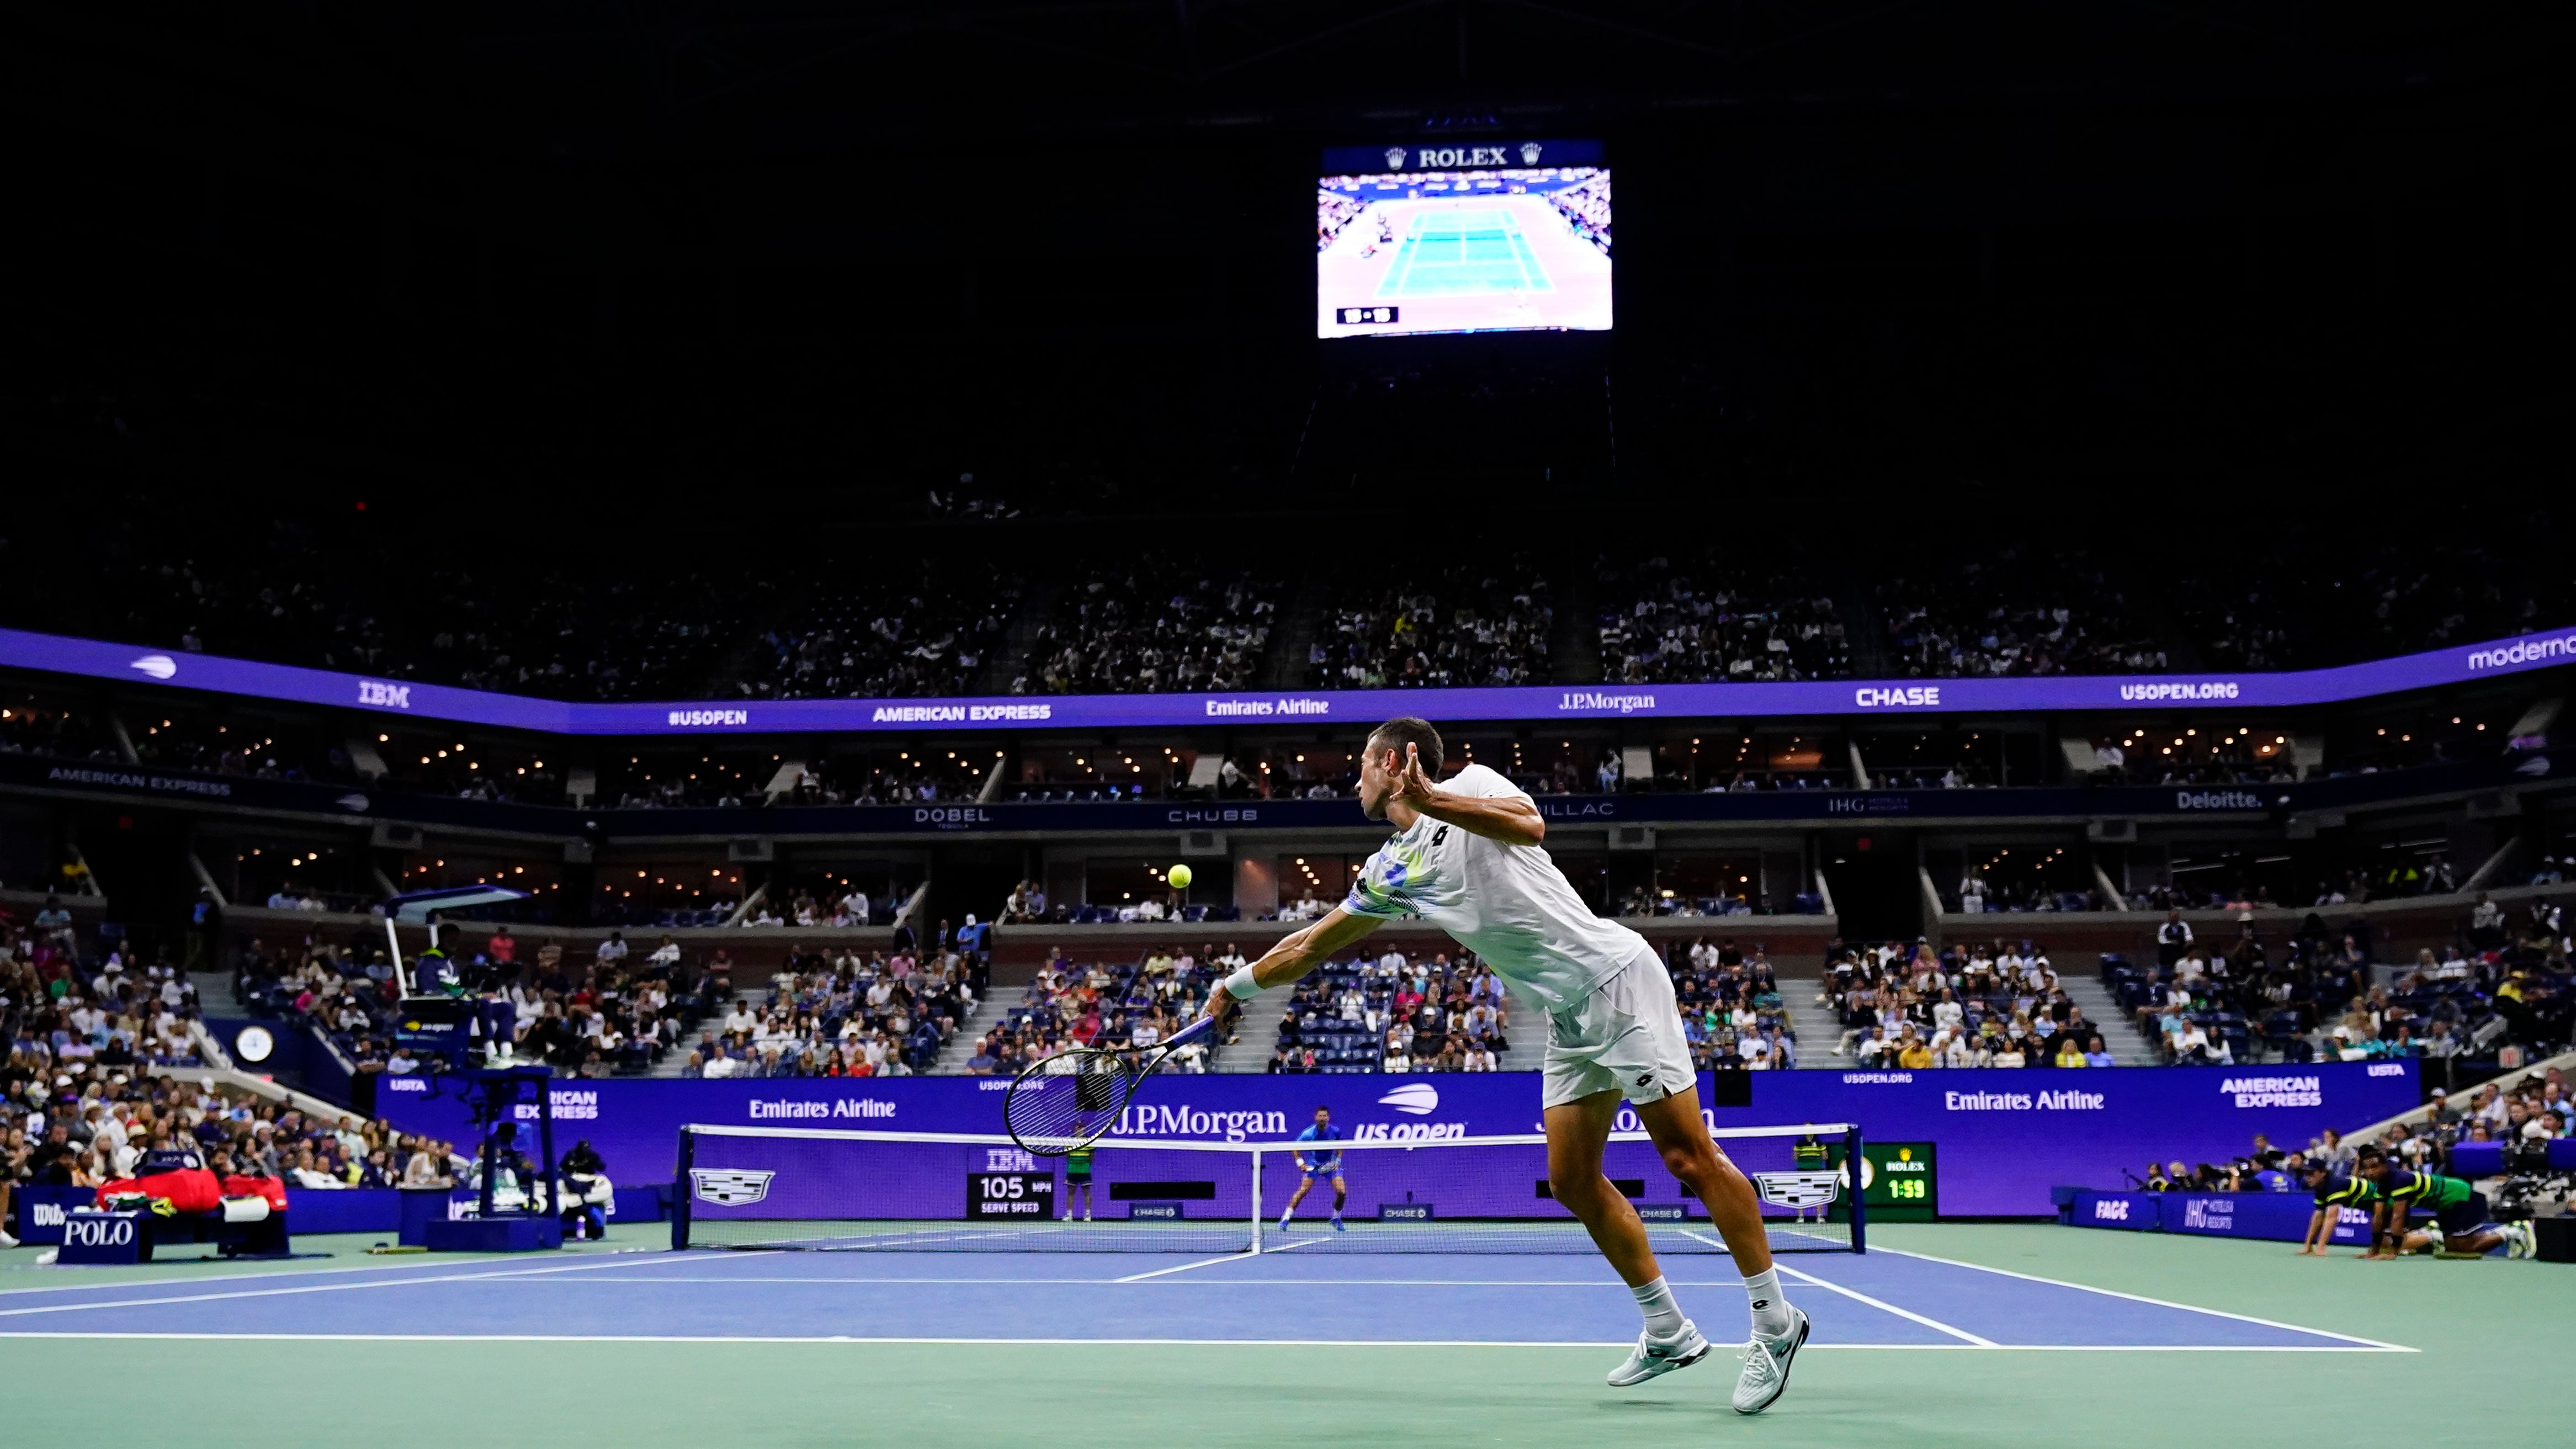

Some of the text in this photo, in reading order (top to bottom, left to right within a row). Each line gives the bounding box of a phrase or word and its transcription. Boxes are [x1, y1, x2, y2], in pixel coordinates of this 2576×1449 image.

[1419, 146, 1508, 167] ROLEX
[359, 681, 411, 708] IBM
[1856, 687, 1940, 707] CHASE
[2121, 682, 2239, 700] USOPEN.ORG
[1207, 698, 1329, 716] Emirates Airline
[1558, 692, 1655, 713] J.P.Morgan
[669, 710, 747, 726] #USOPEN
[873, 704, 1051, 722] AMERICAN EXPRESS
[49, 767, 231, 797] AMERICAN EXPRESS
[1828, 798, 1864, 812] IHG
[915, 808, 990, 822] DOBEL
[1168, 810, 1257, 822] CHUBB
[1842, 1073, 1913, 1084] USOPEN.ORG
[2367, 1064, 2405, 1076] USTA
[390, 1079, 427, 1091] USTA
[2220, 1076, 2320, 1094] AMERICAN
[750, 1098, 896, 1118] Emirates Airline
[1946, 1090, 2104, 1110] Emirates Airline
[2235, 1091, 2322, 1108] EXPRESS
[1111, 1105, 1287, 1143] J.P.Morgan
[987, 1149, 1038, 1171] IBM
[1886, 1161, 1925, 1171] ROLEX
[980, 1176, 1051, 1198] 105 MPH
[1888, 1179, 1925, 1198] 1:59
[981, 1202, 1039, 1213] SERVE SPEED
[1135, 1208, 1166, 1216] CHASE
[1385, 1209, 1416, 1217] CHASE
[1640, 1209, 1672, 1218] CHASE
[2184, 1198, 2208, 1229] IHG
[64, 1219, 133, 1246] POLO
